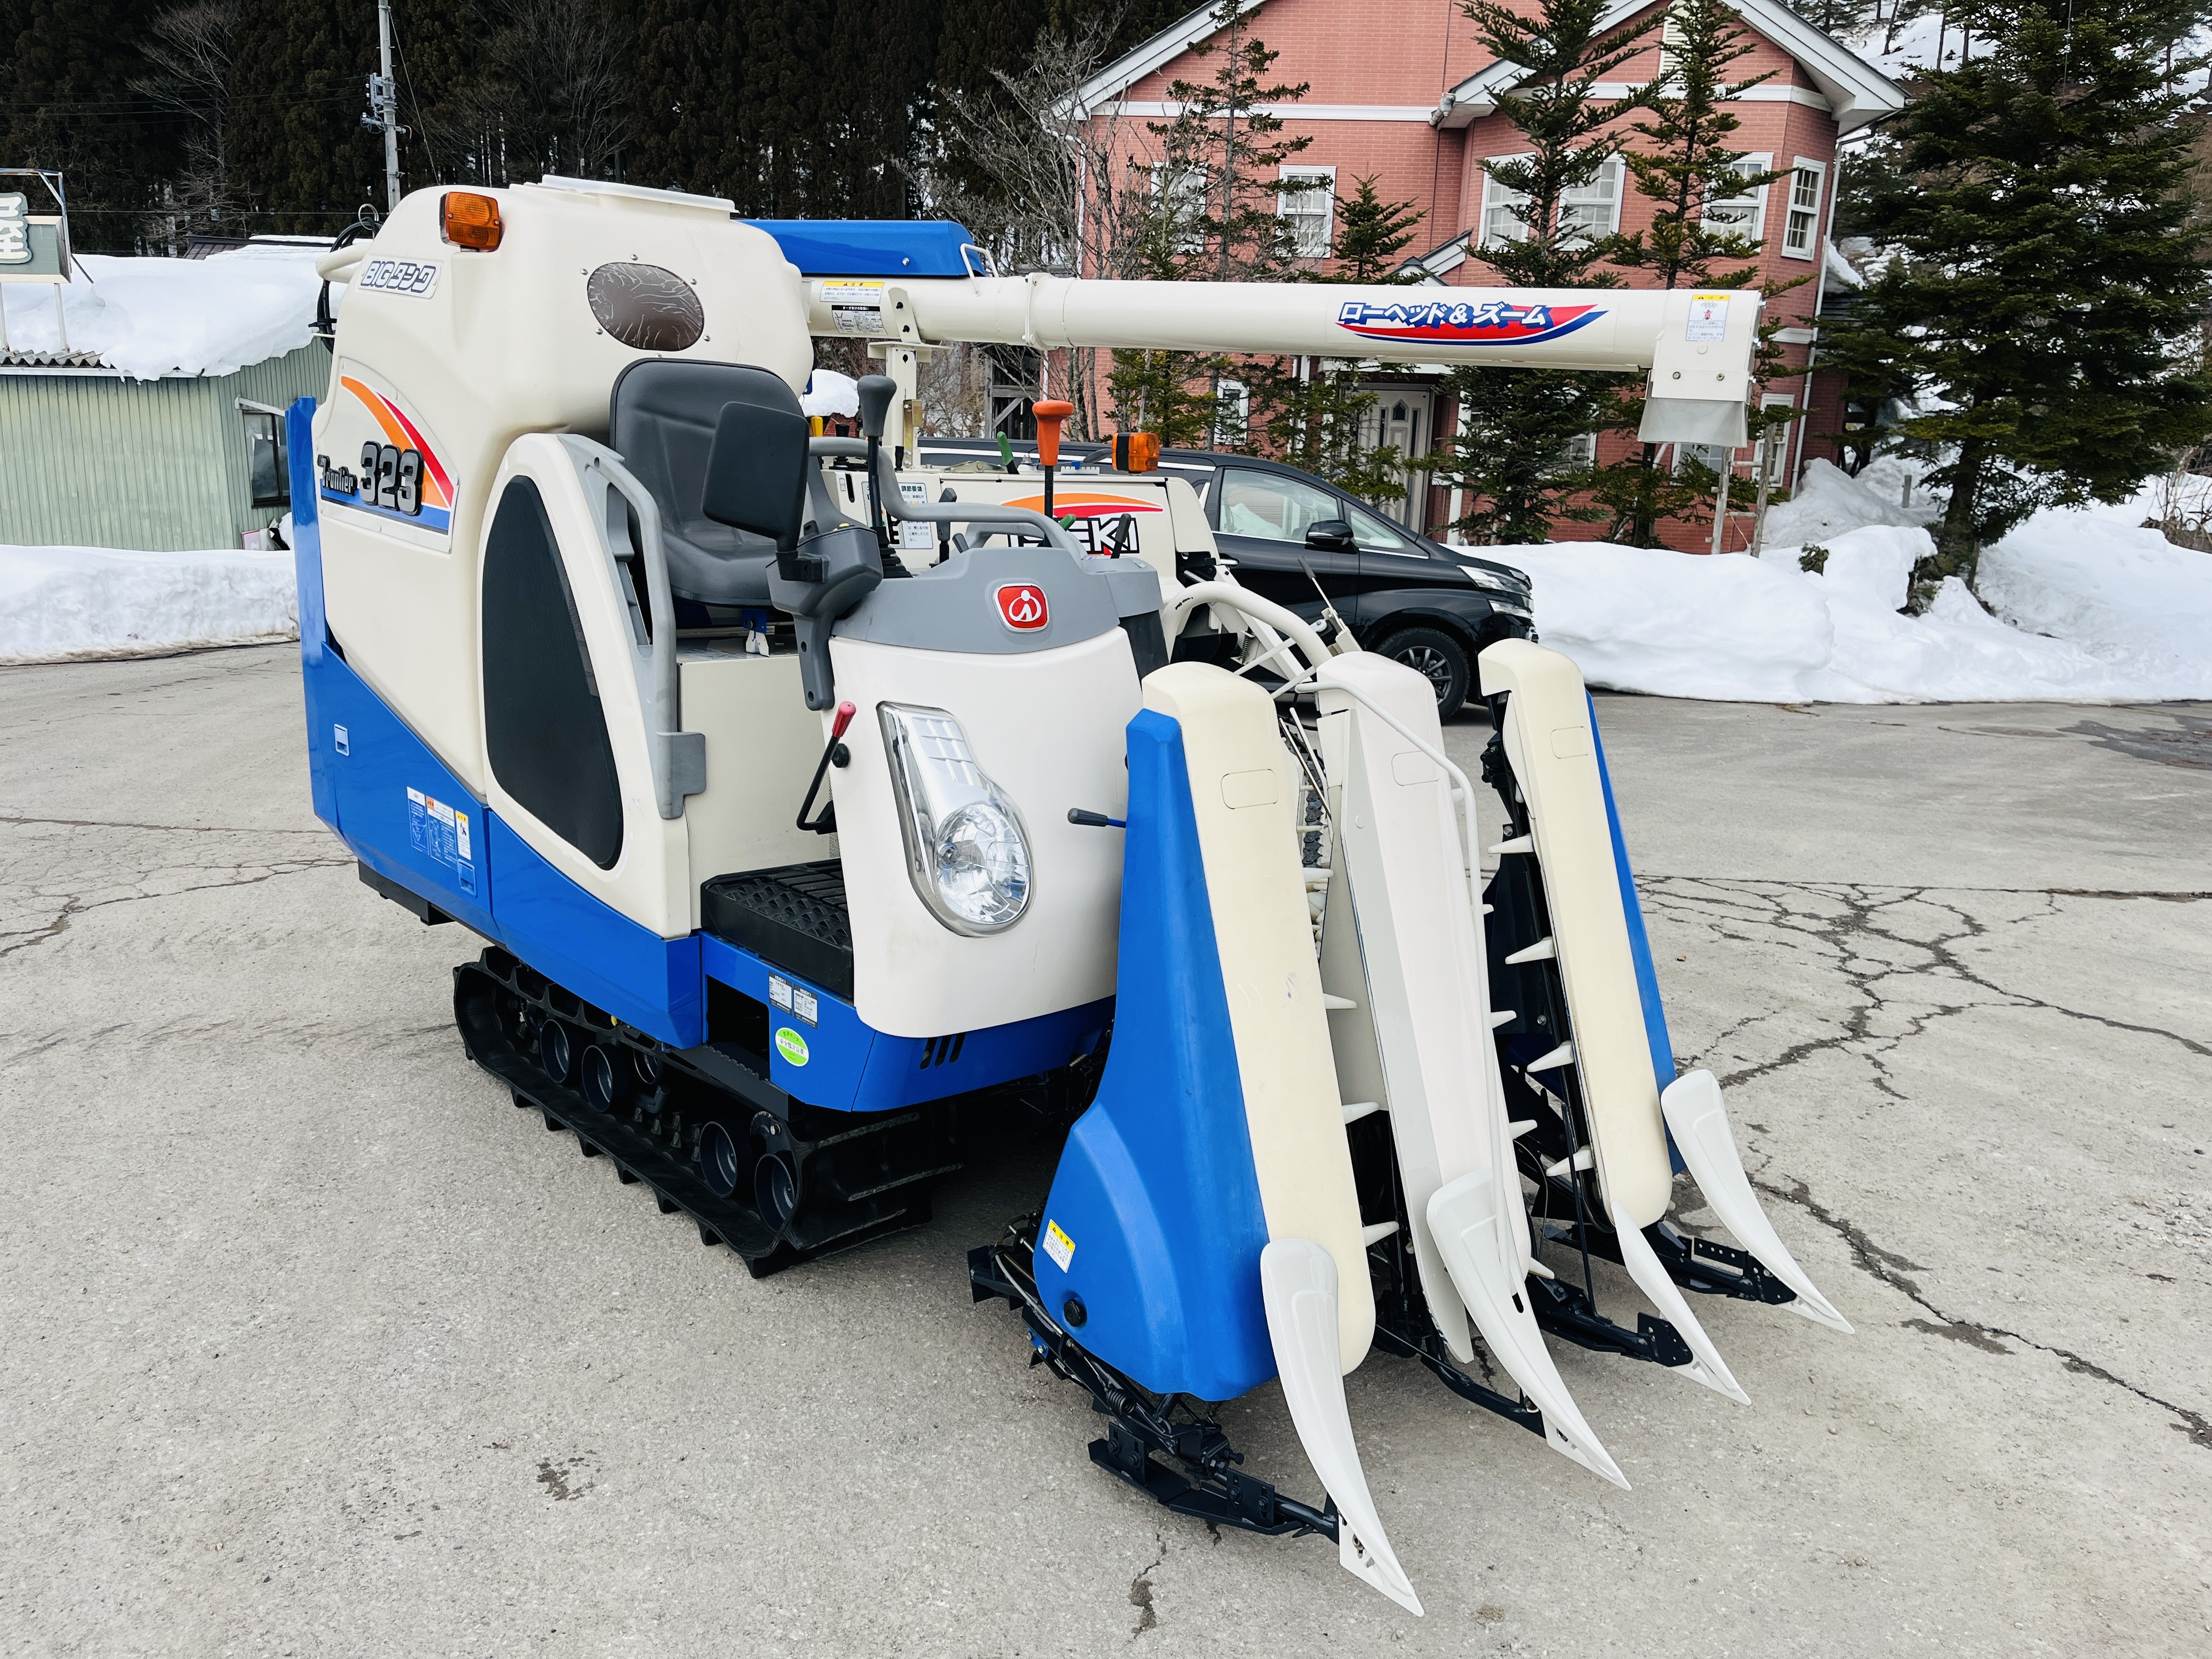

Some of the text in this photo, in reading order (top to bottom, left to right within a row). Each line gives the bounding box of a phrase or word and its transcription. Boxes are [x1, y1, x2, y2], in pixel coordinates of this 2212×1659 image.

[359, 441, 425, 516] 323
[775, 975, 786, 984] ISEKI
[799, 988, 811, 997] ISEKI
